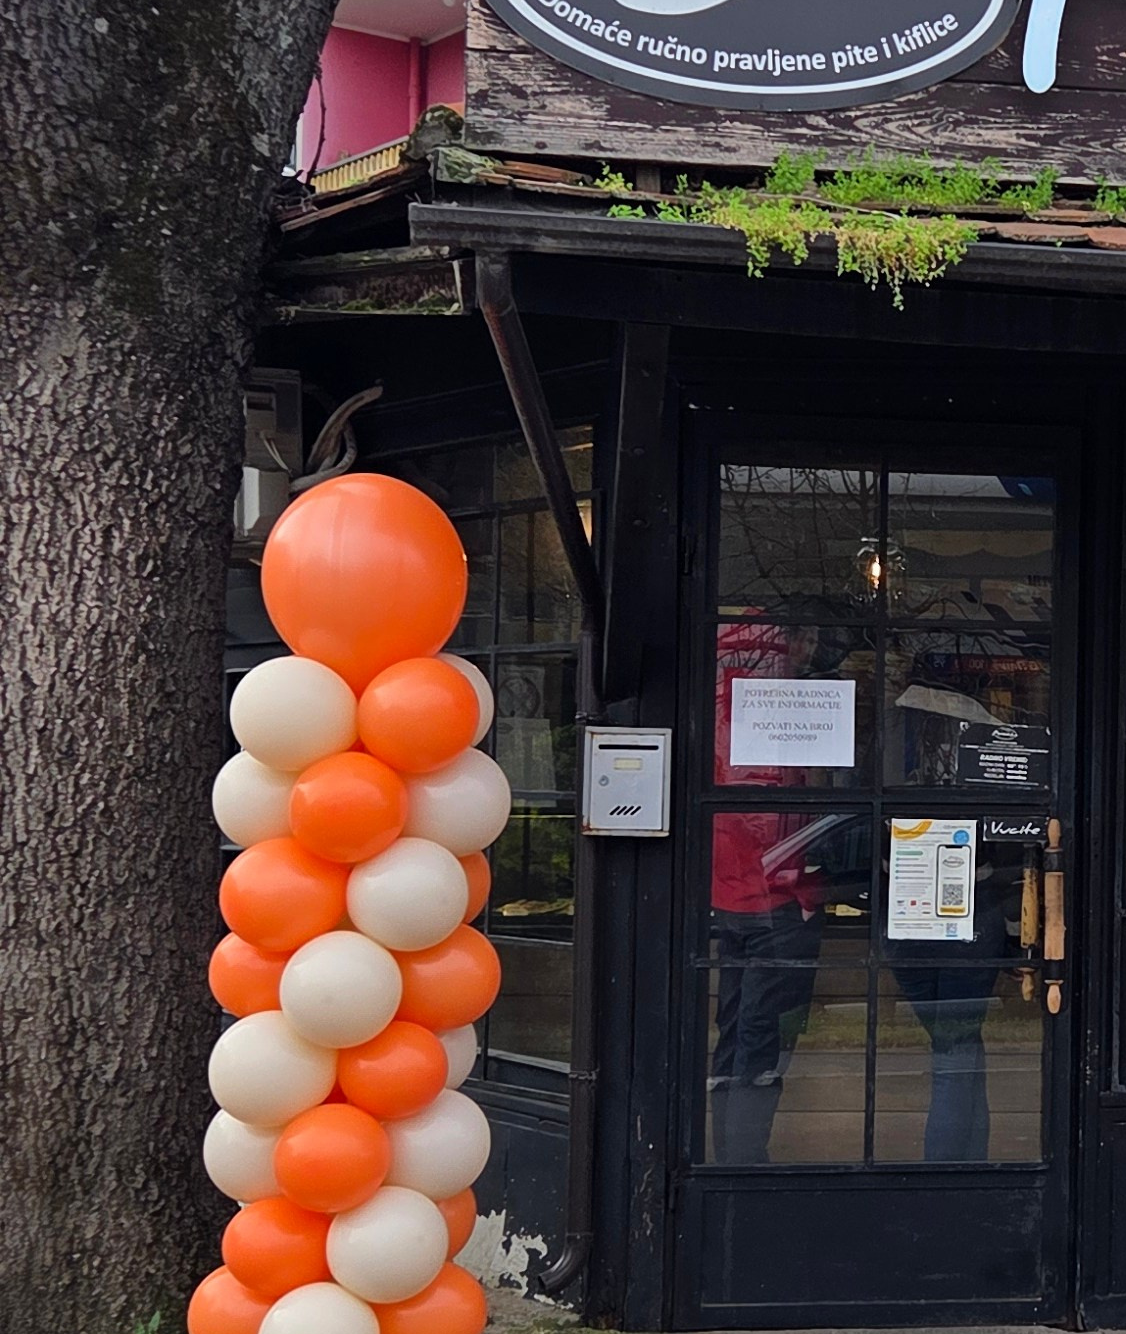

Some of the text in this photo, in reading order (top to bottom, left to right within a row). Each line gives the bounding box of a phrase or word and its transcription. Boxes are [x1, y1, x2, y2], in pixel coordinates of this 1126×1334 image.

[636, 33, 708, 66] ručno
[713, 46, 827, 78] pravljene
[831, 45, 879, 74] pite
[884, 37, 893, 60] i
[896, 10, 959, 56] kiflice
[744, 689, 841, 698] POTREBNA RADNICA
[742, 700, 841, 710] ZA SVE INFORMACIJE
[752, 722, 833, 731] POZVATI NA BROJ
